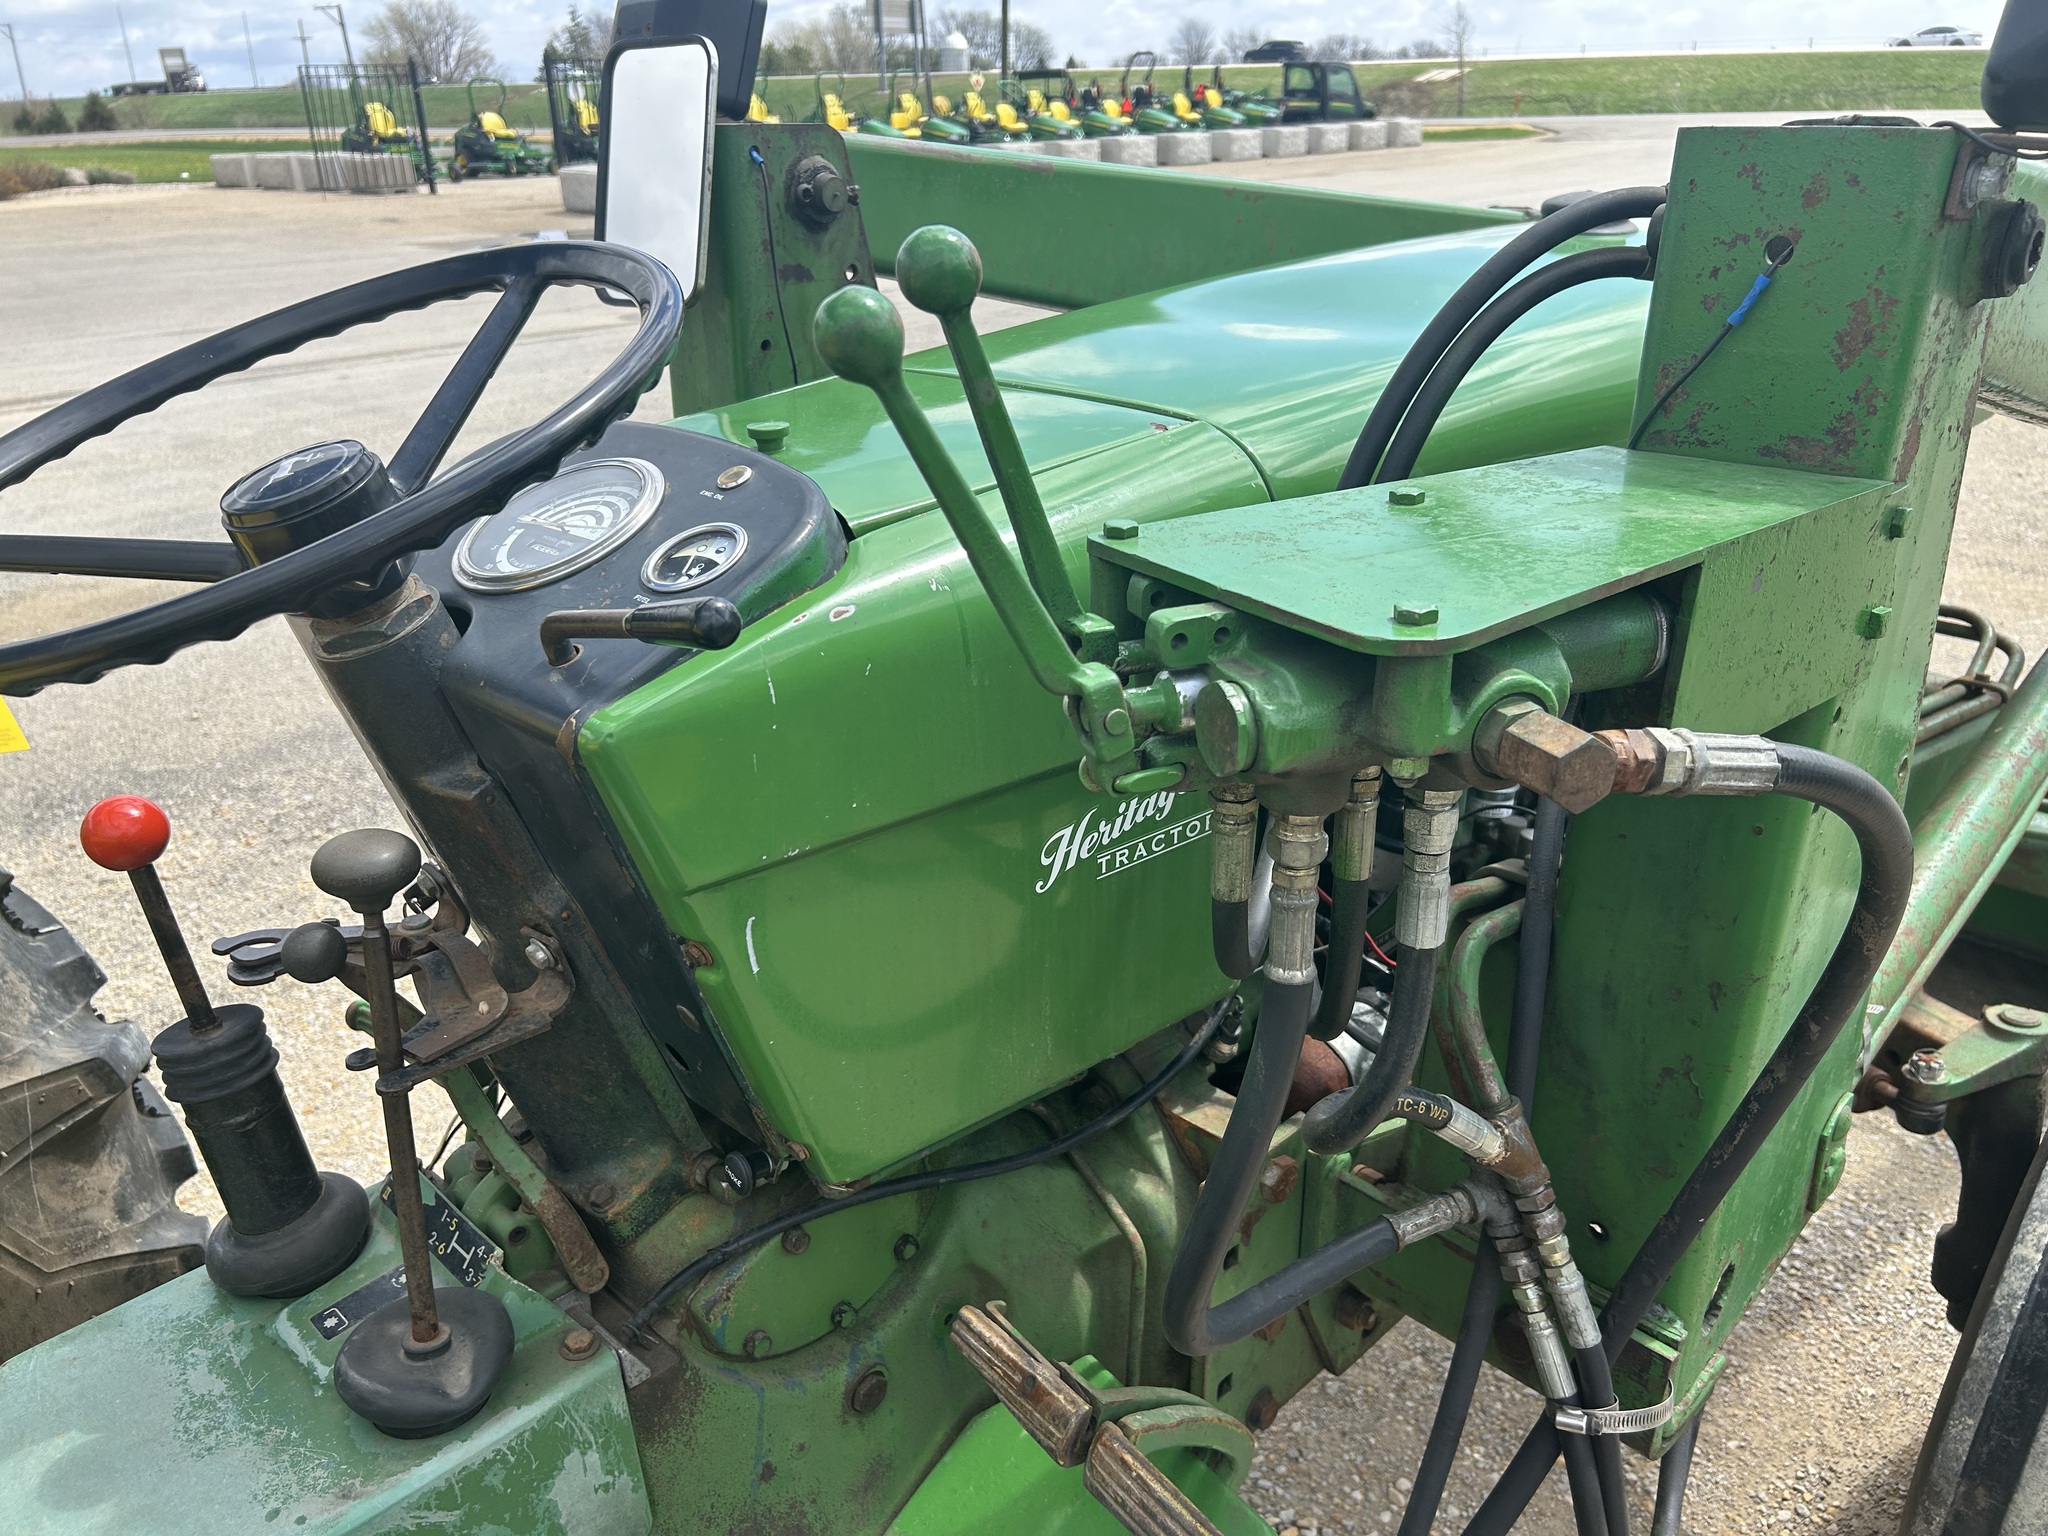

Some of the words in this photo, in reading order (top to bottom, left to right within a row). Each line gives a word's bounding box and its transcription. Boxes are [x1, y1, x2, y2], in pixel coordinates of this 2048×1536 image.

[633, 594, 651, 604] FUEL
[1035, 790, 1187, 894] Heritag
[1429, 1103, 1449, 1121] WP
[724, 1164, 742, 1188] CHOKE
[441, 1208, 459, 1231] 1-5
[428, 1231, 446, 1255] 2-6
